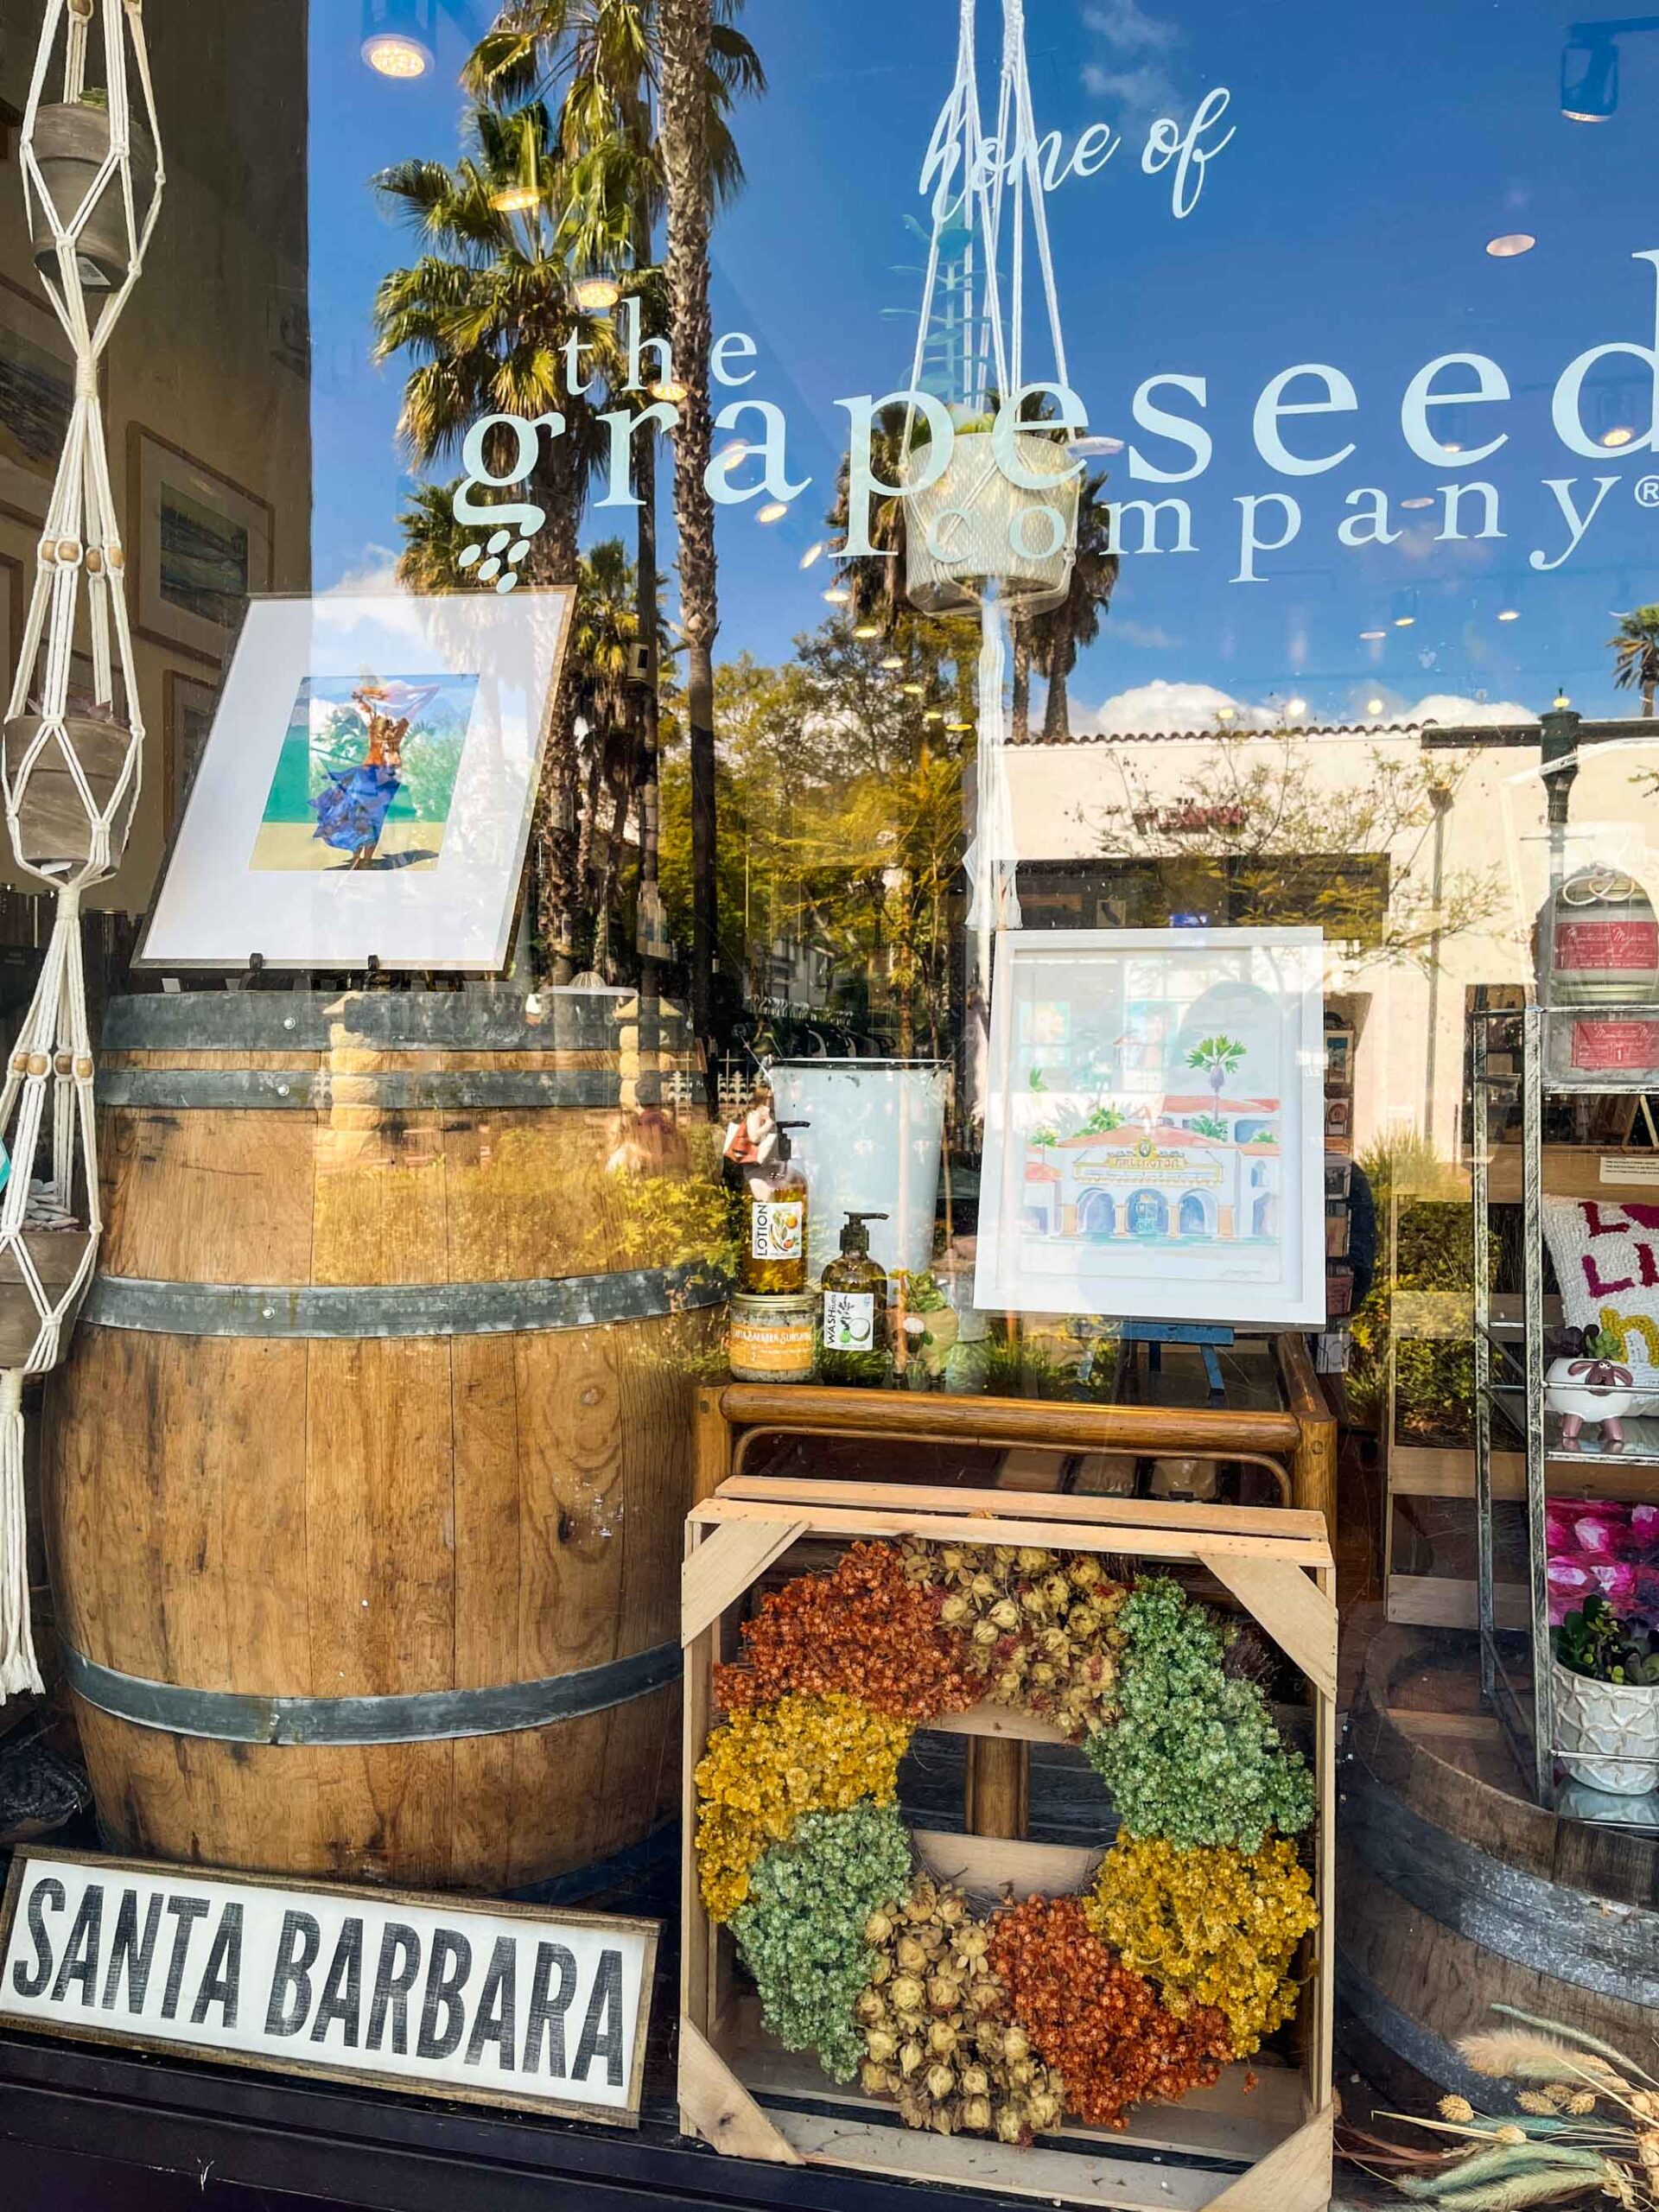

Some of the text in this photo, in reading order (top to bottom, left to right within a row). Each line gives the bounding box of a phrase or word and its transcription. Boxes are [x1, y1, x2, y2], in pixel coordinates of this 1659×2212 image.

[918, 79, 1236, 223] home of
[453, 250, 1659, 558] grapeseed
[558, 296, 757, 396] the
[757, 1205, 768, 1256] LOTION
[12, 1877, 624, 2088] SANTA BARBARA
